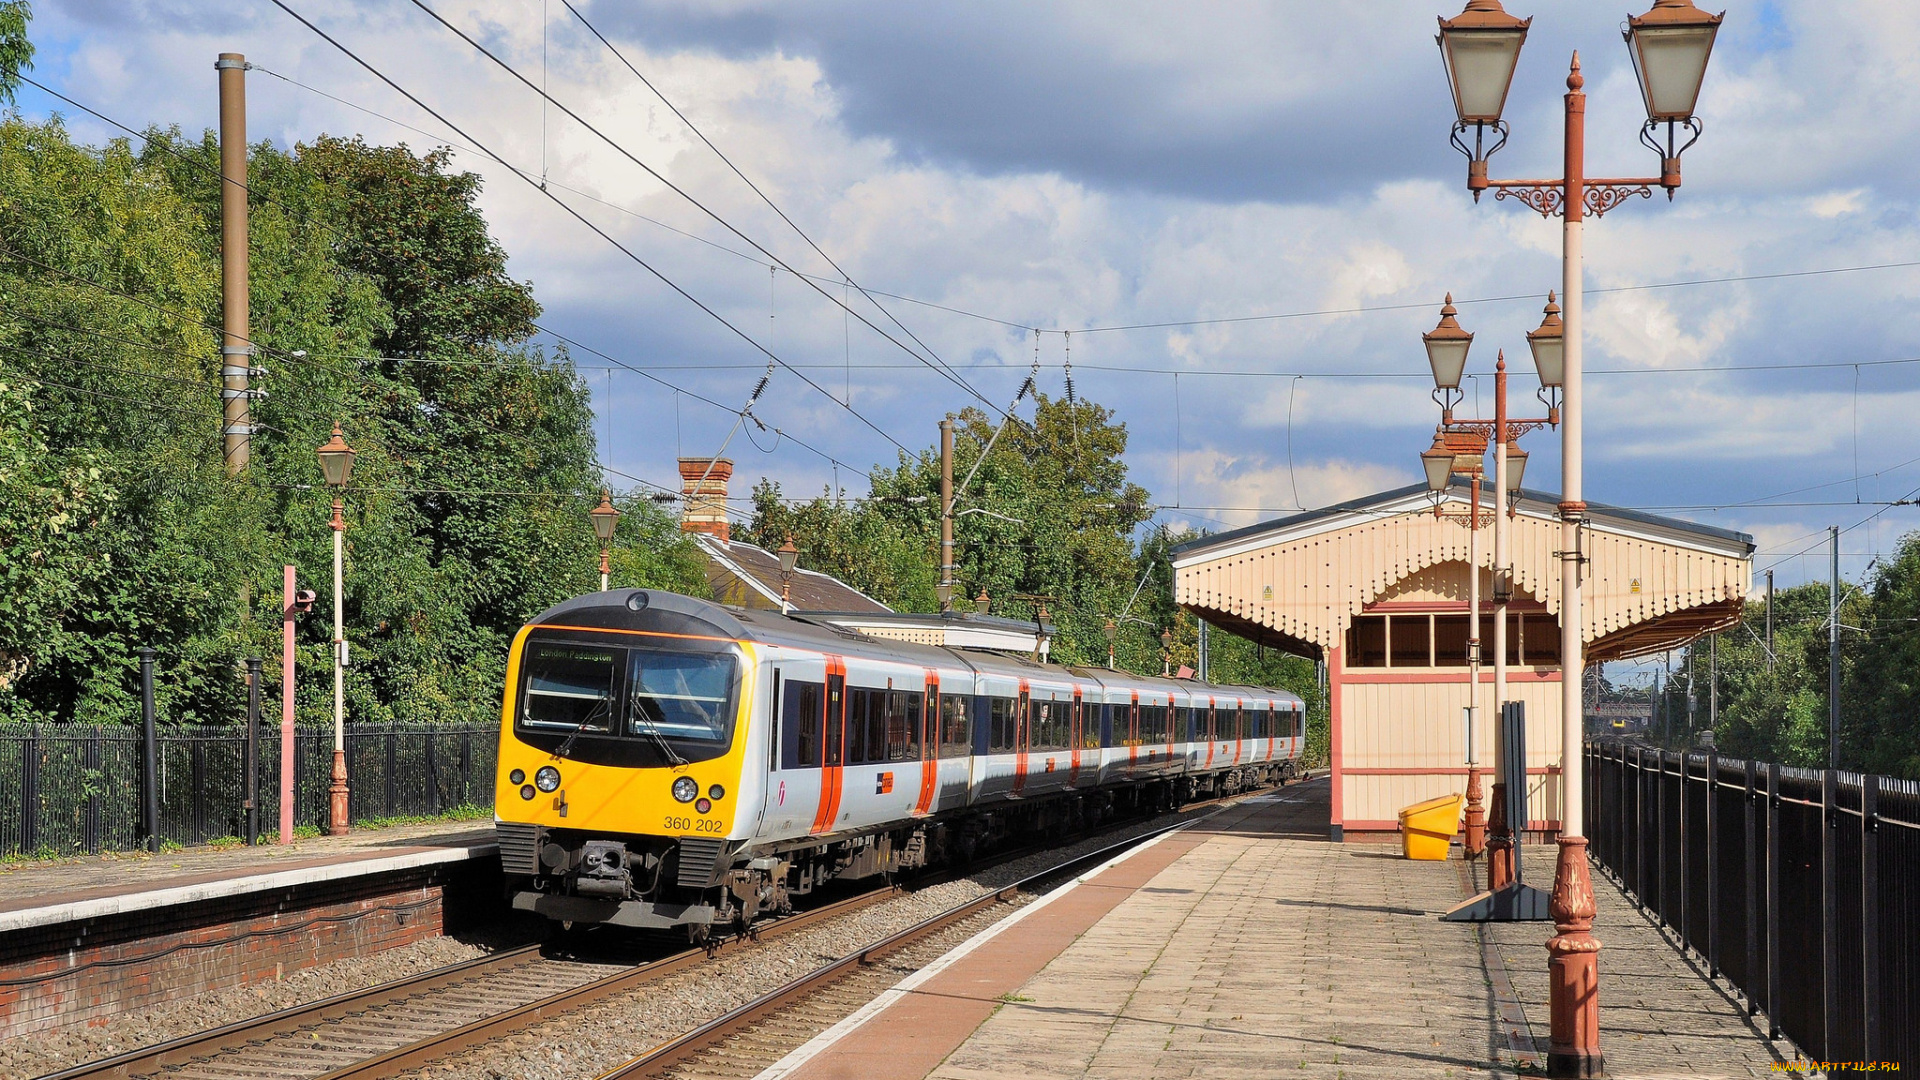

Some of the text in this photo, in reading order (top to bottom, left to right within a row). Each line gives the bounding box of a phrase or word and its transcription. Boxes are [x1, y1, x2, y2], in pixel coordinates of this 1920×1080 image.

[540, 649, 612, 662] London Paddington
[663, 816, 723, 833] 360 202
